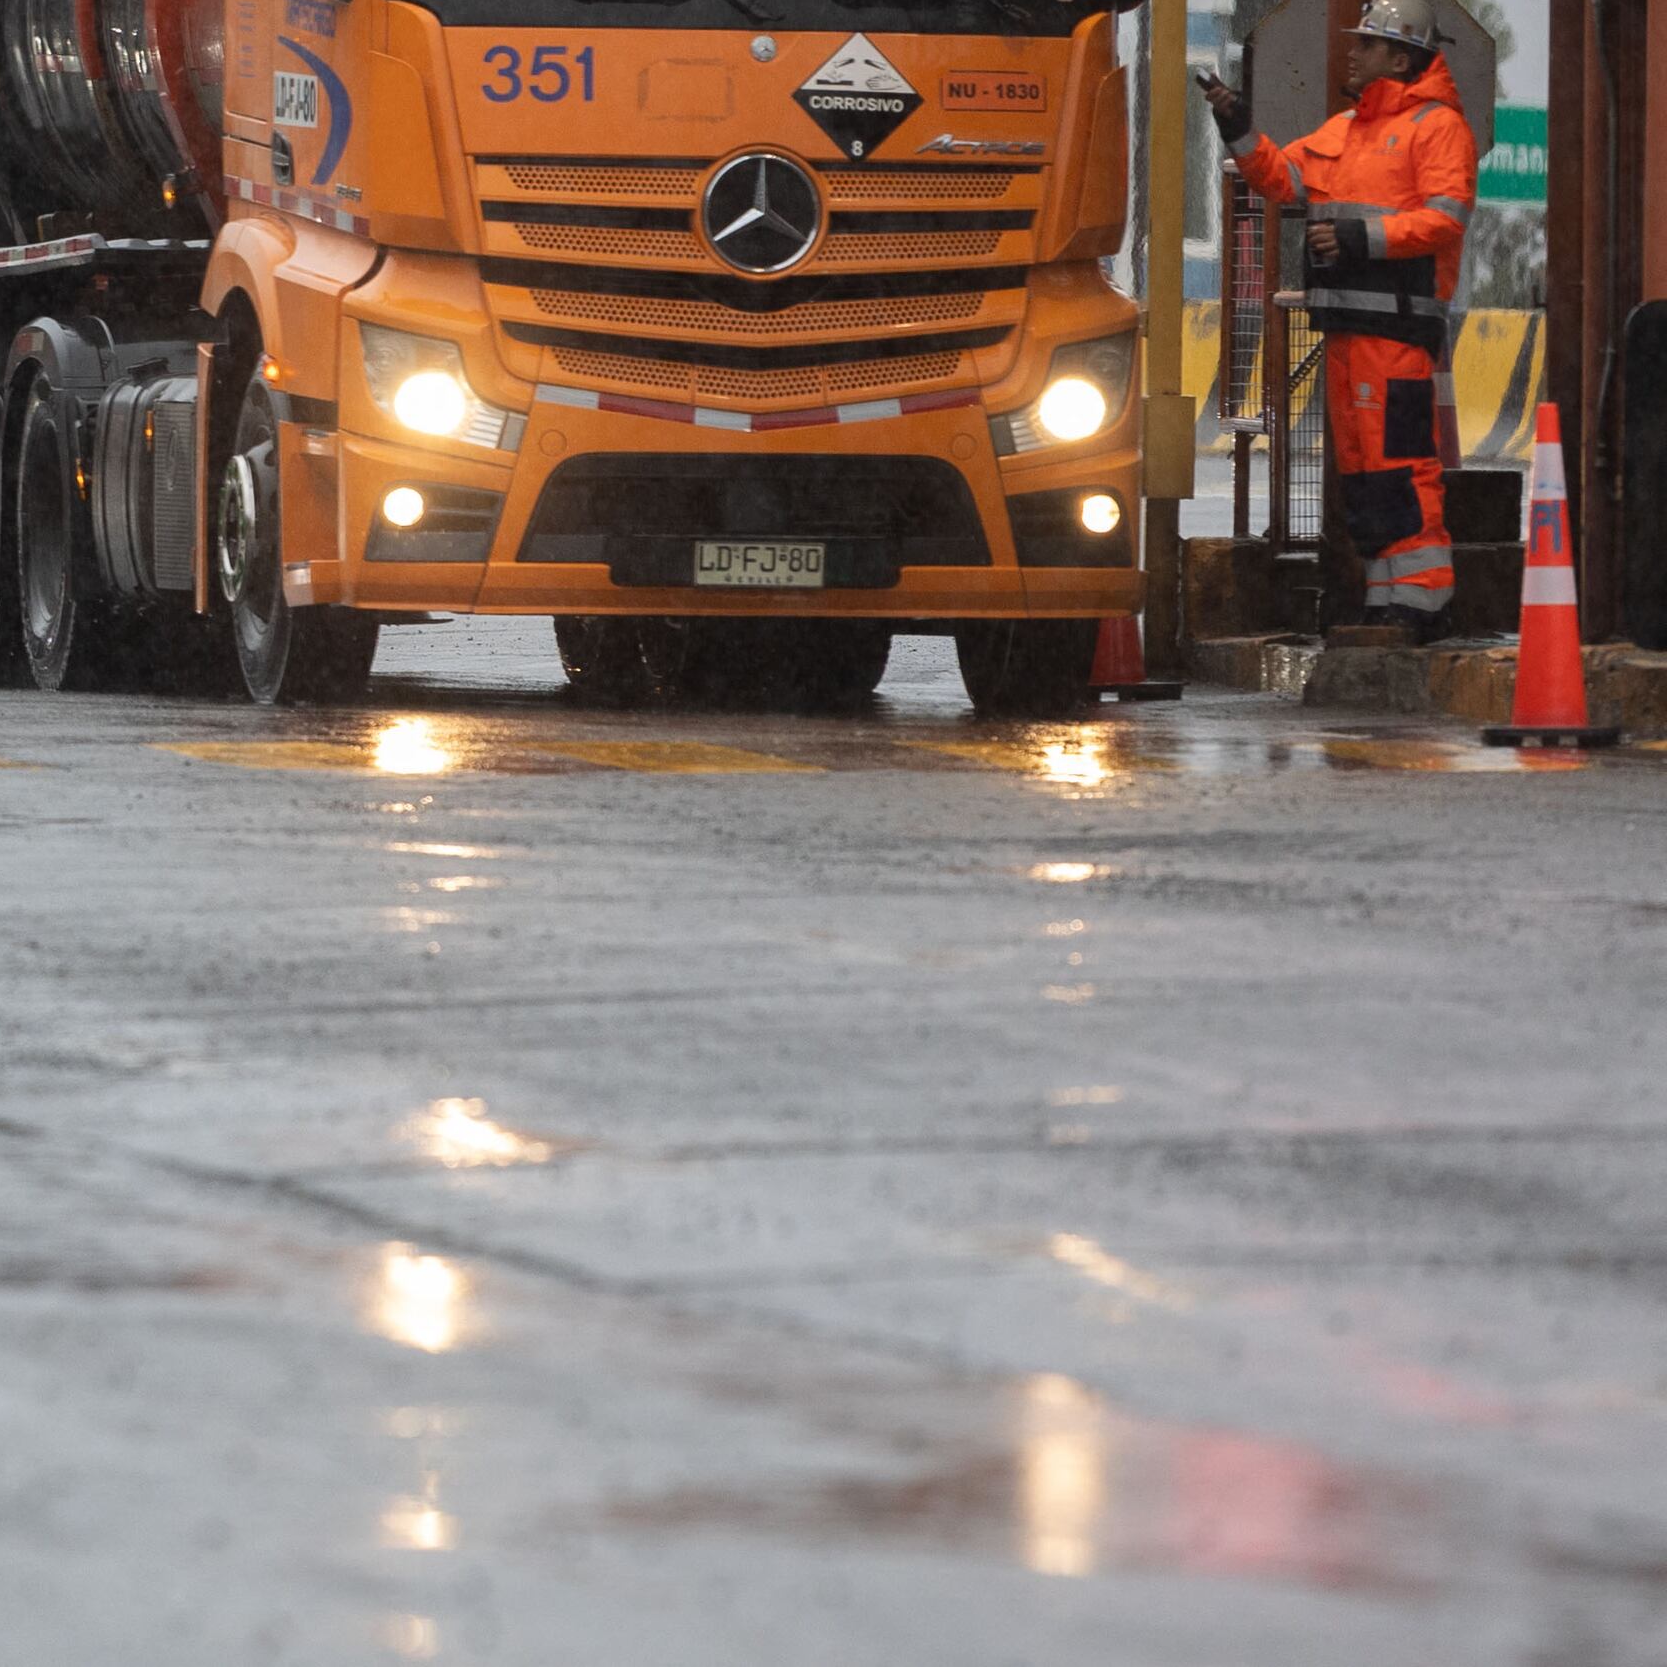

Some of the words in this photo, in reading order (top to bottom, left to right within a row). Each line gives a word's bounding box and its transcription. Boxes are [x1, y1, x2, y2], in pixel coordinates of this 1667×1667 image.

[480, 45, 595, 103] 351
[948, 84, 976, 99] NU
[995, 84, 1040, 100] 1830
[808, 95, 905, 113] CORROSIVO
[851, 140, 864, 157] 8
